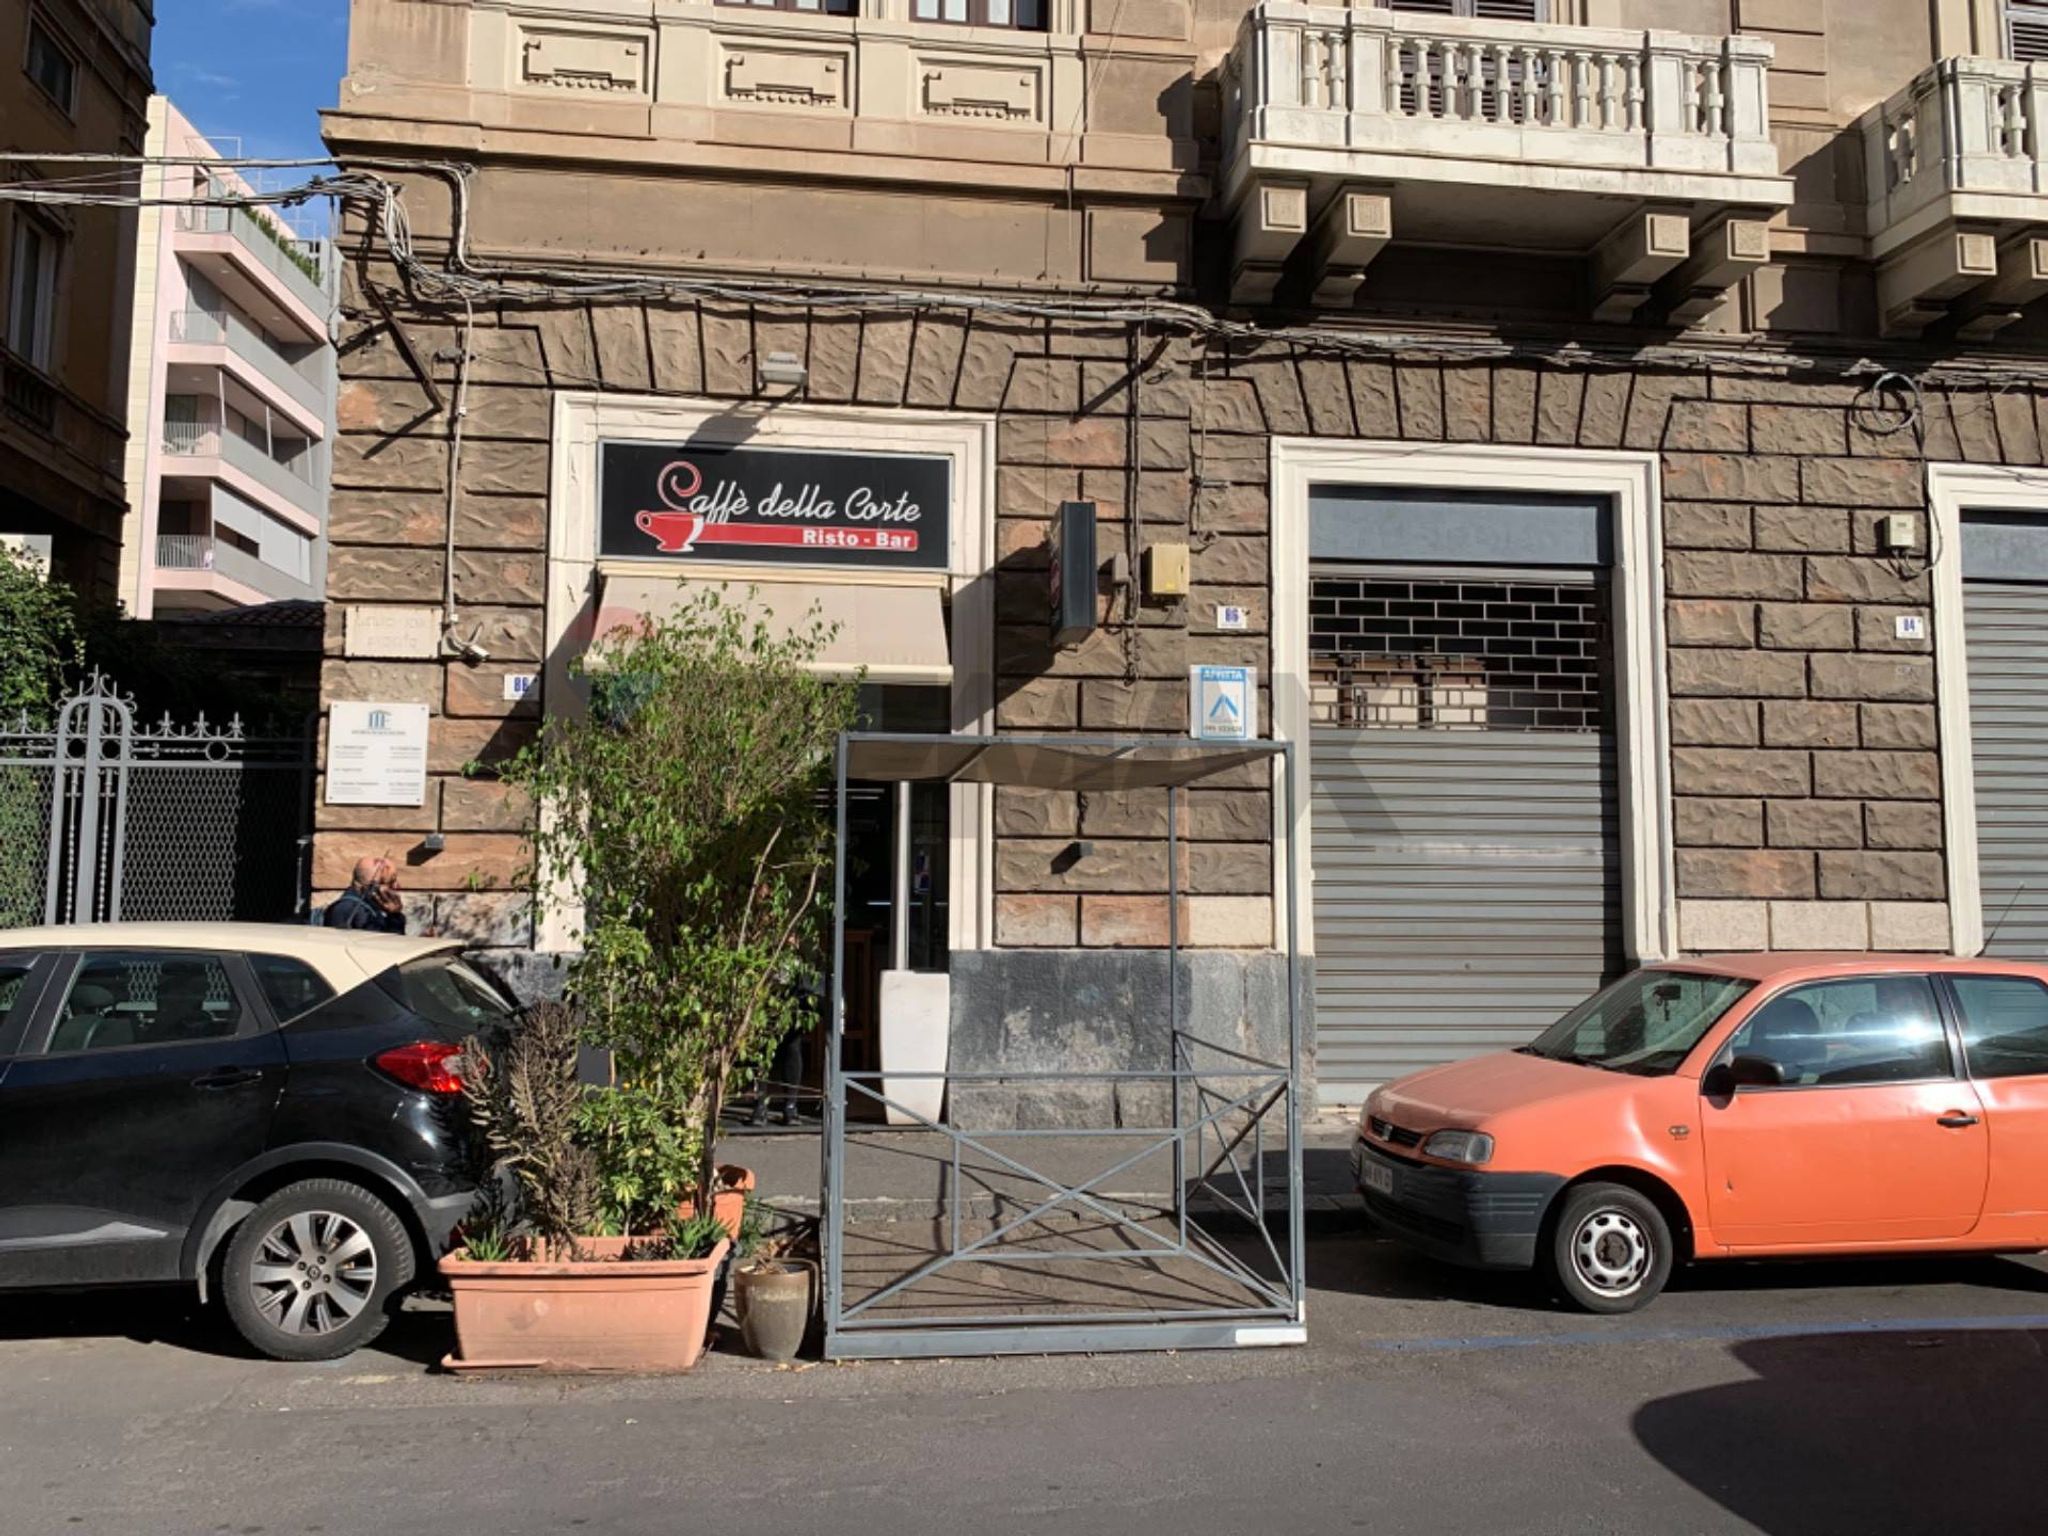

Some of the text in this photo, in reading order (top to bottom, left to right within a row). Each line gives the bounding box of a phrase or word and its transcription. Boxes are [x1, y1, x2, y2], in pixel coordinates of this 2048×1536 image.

[657, 460, 922, 524] Caffè della Corte
[803, 529, 859, 547] Risto
[875, 532, 912, 548] Bar
